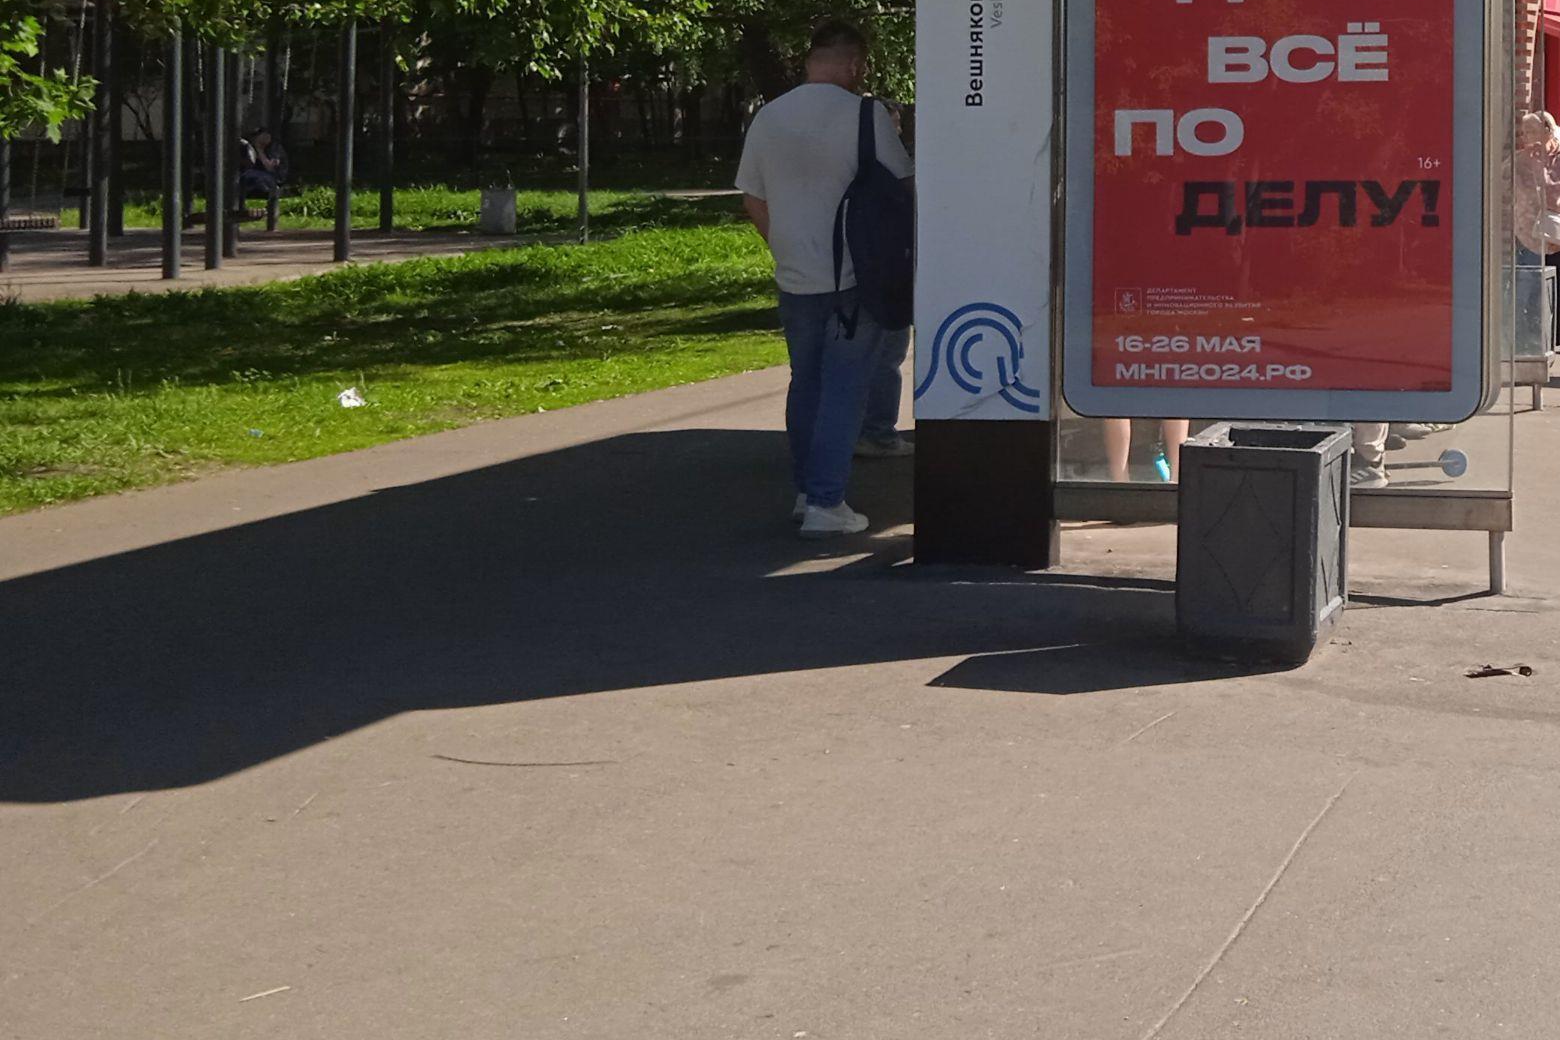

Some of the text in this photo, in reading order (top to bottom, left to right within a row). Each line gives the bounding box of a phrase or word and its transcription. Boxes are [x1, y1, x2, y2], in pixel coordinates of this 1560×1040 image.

[1207, 22, 1389, 84] ВСЁ
[1114, 107, 1245, 157] ПО
[1417, 157, 1441, 170] 16+
[1175, 180, 1441, 236] ДЕЛУ!
[1115, 335, 1262, 353] 16-26 МАЯ
[1114, 363, 1312, 381] МНП2024.РФ
